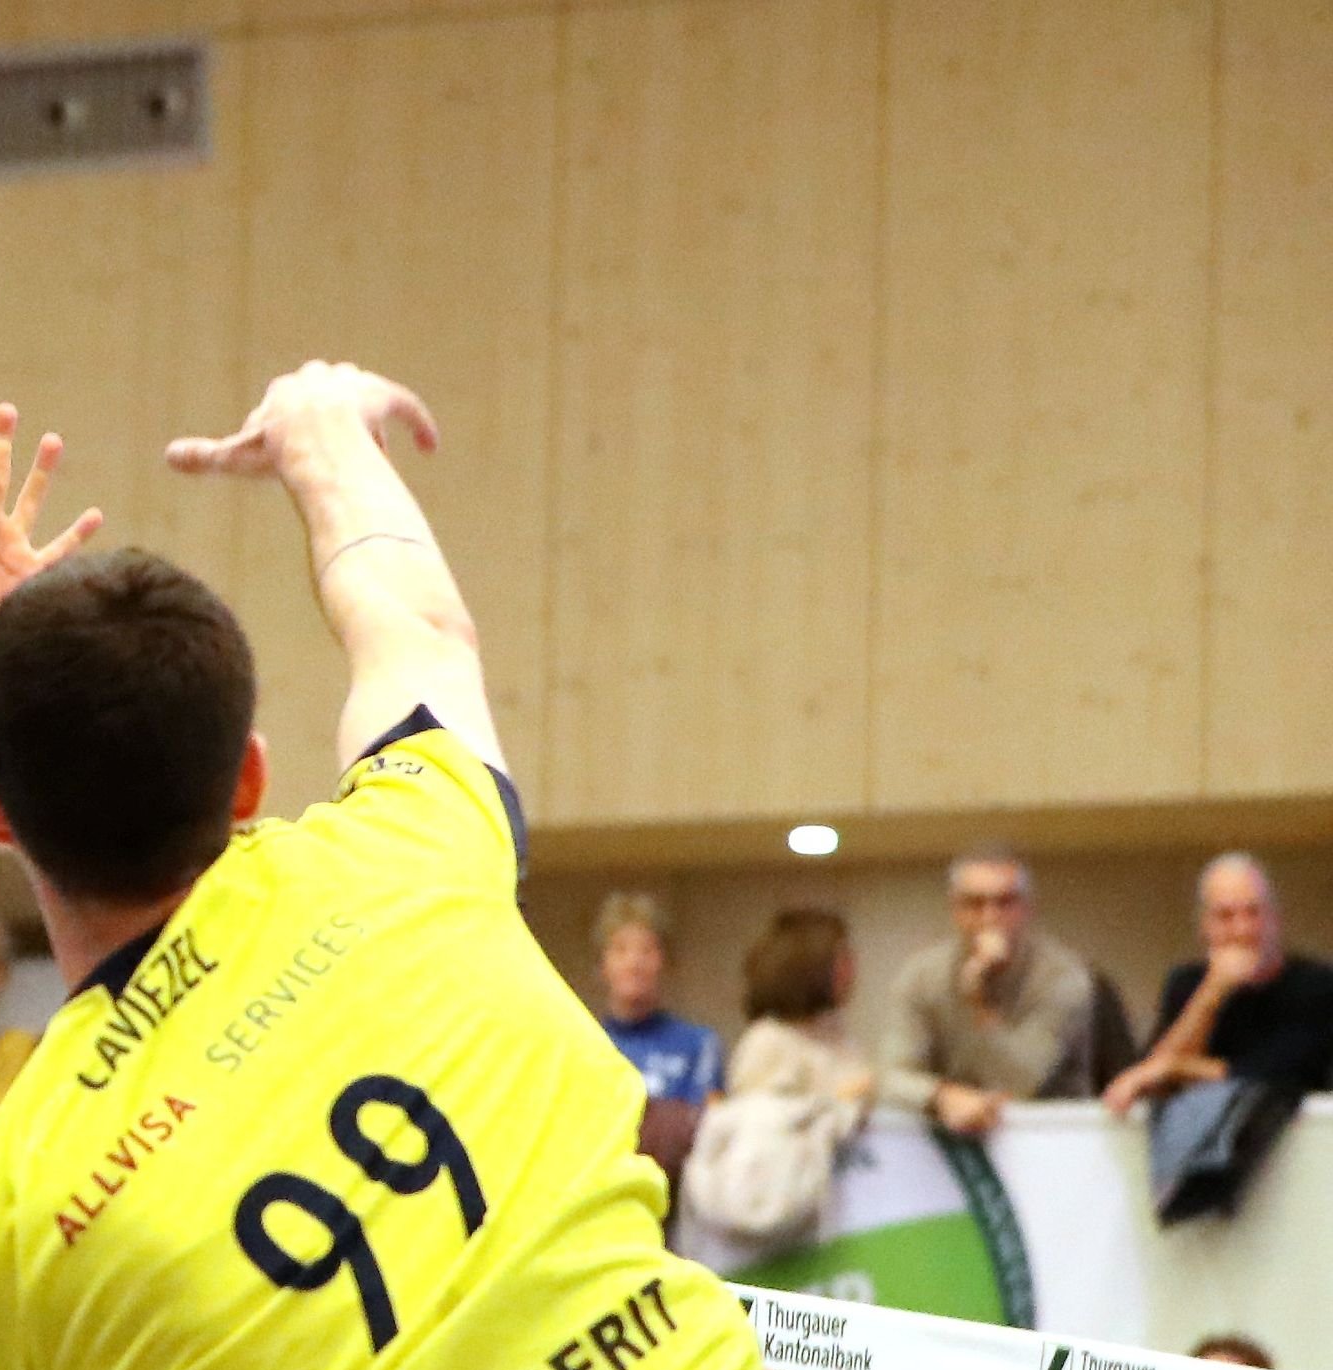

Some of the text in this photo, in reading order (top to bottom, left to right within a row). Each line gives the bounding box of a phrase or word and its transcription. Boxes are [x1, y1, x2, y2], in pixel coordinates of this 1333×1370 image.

[54, 912, 366, 1248] ALLVISA SERVICES
[233, 1073, 488, 1355] 99
[765, 1299, 848, 1339] Thurgauer
